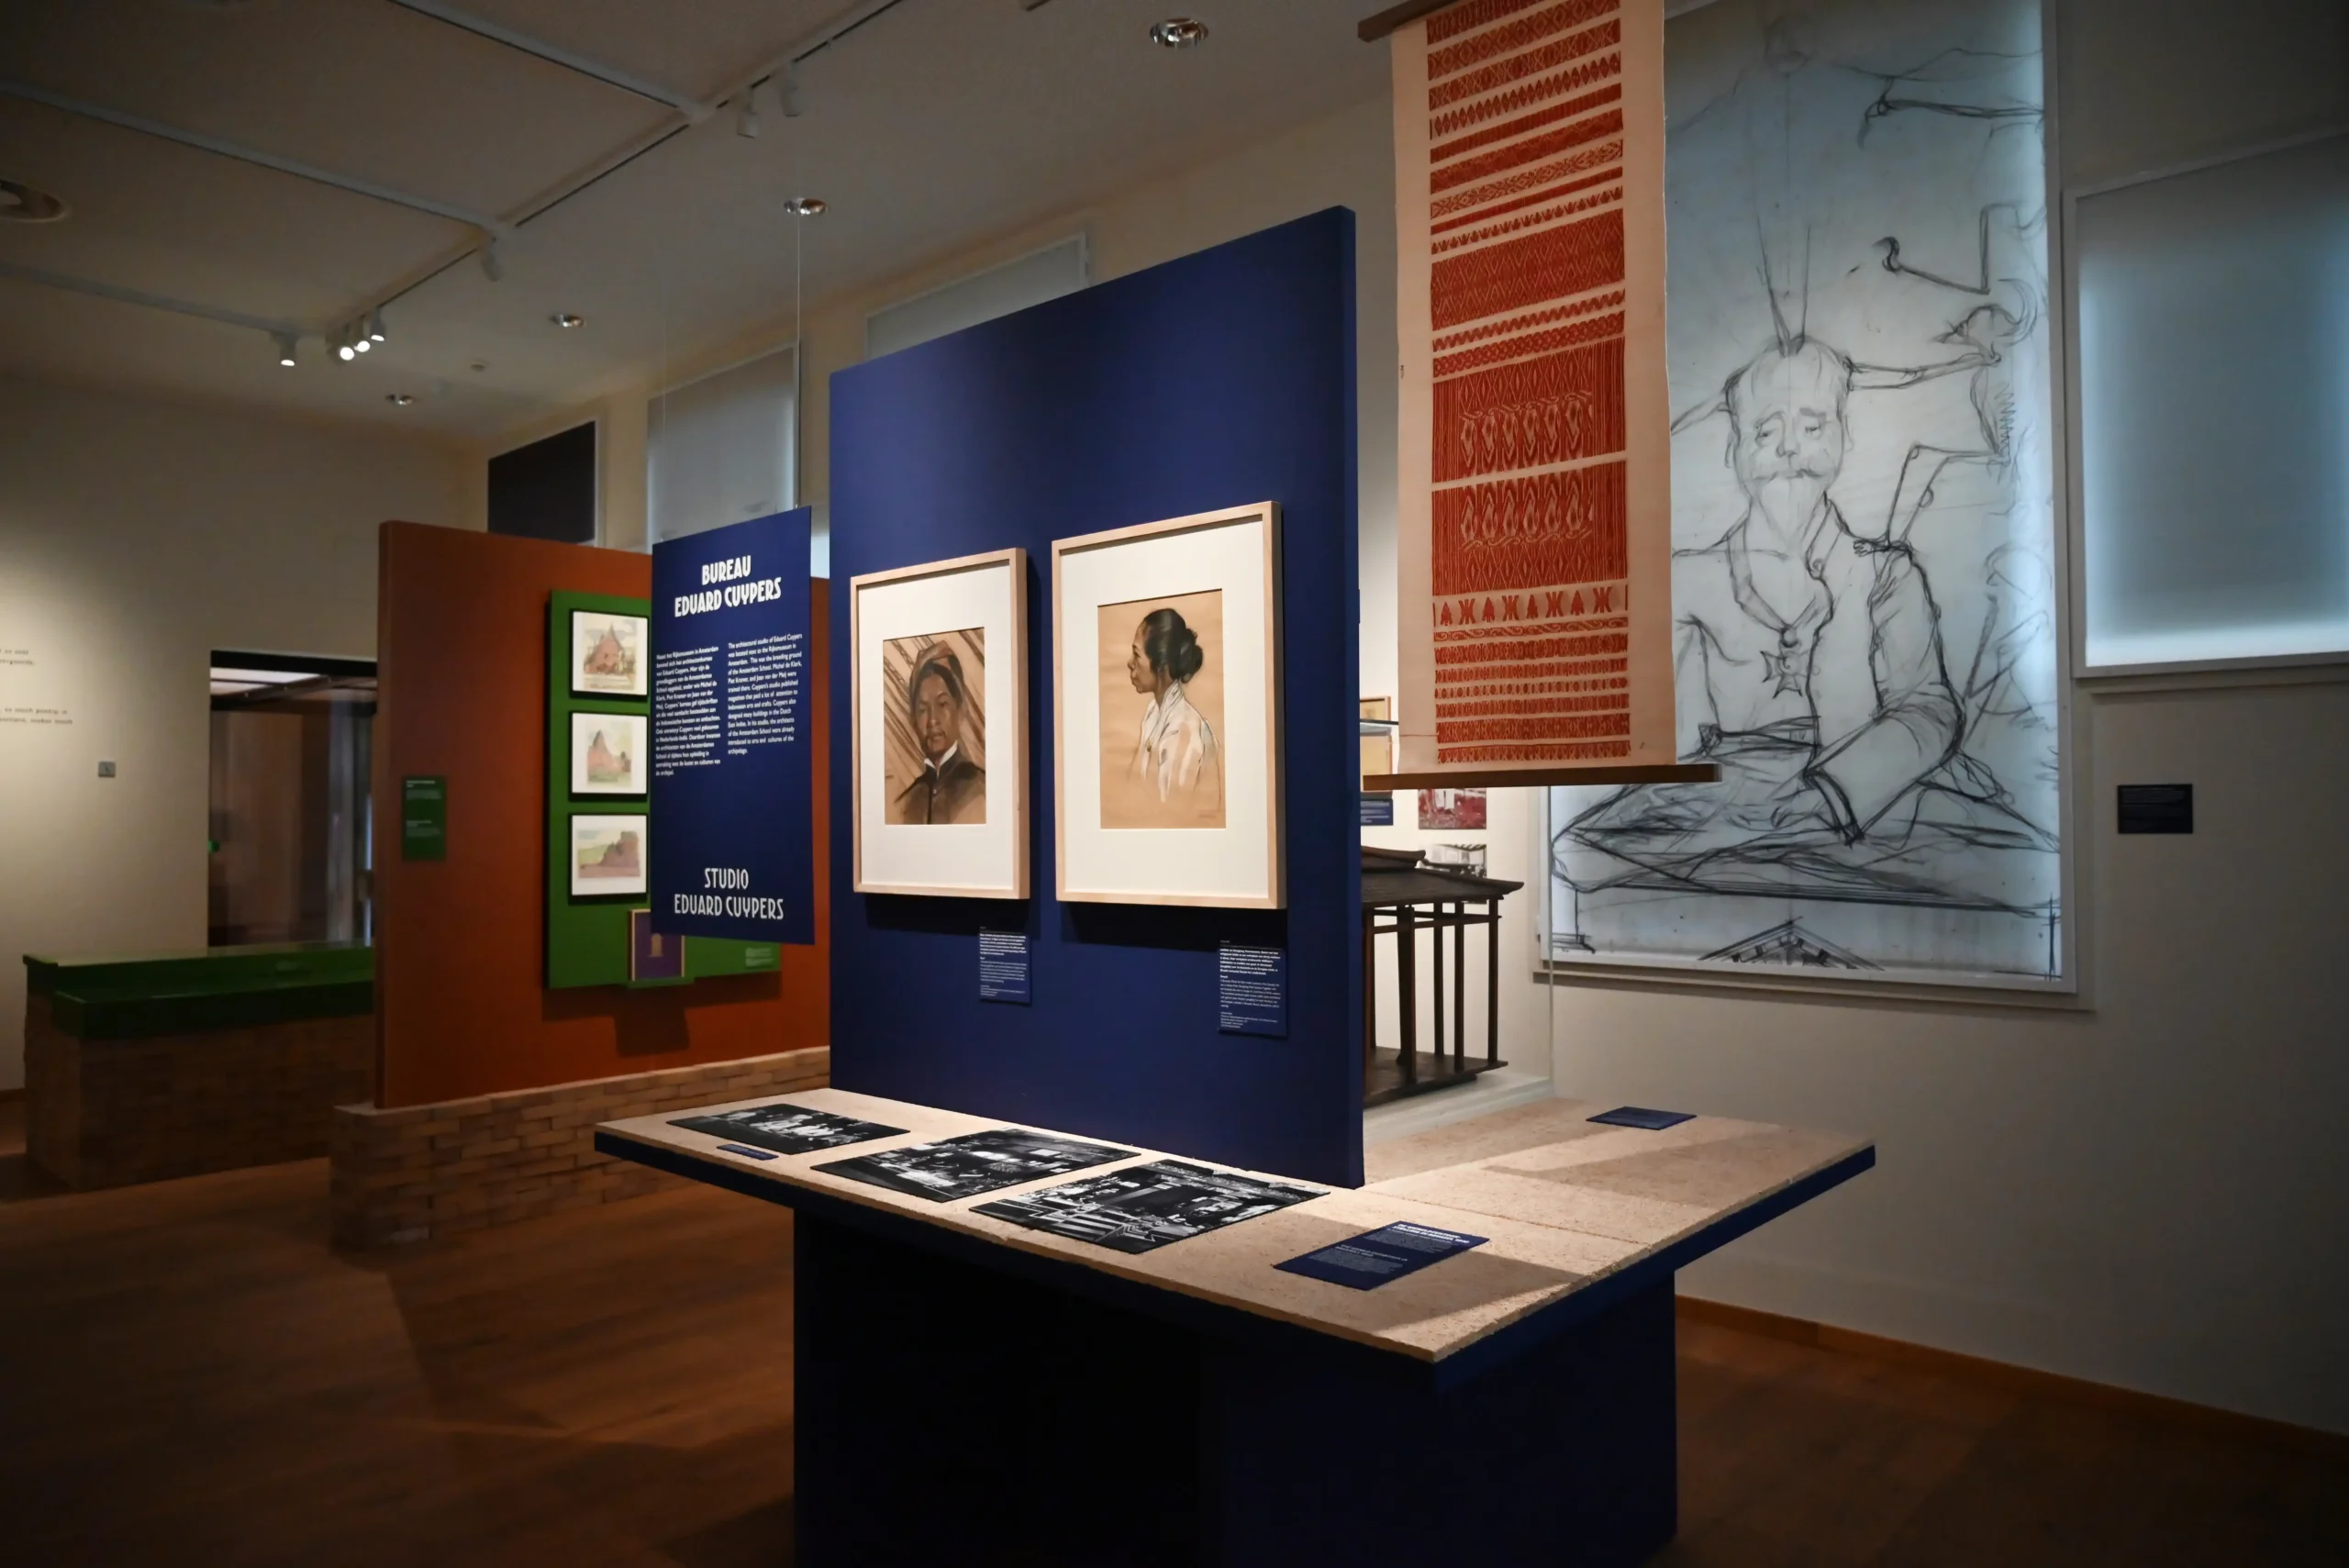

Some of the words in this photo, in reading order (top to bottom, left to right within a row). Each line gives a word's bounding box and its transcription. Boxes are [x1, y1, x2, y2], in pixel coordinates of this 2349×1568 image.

[702, 555, 751, 585] BUREAU
[674, 589, 722, 617] EDUARD
[725, 577, 782, 607] CUYPERS
[704, 868, 749, 890] STUDIO
[674, 894, 722, 917] EDUARD
[726, 895, 784, 920] CUYPERS
